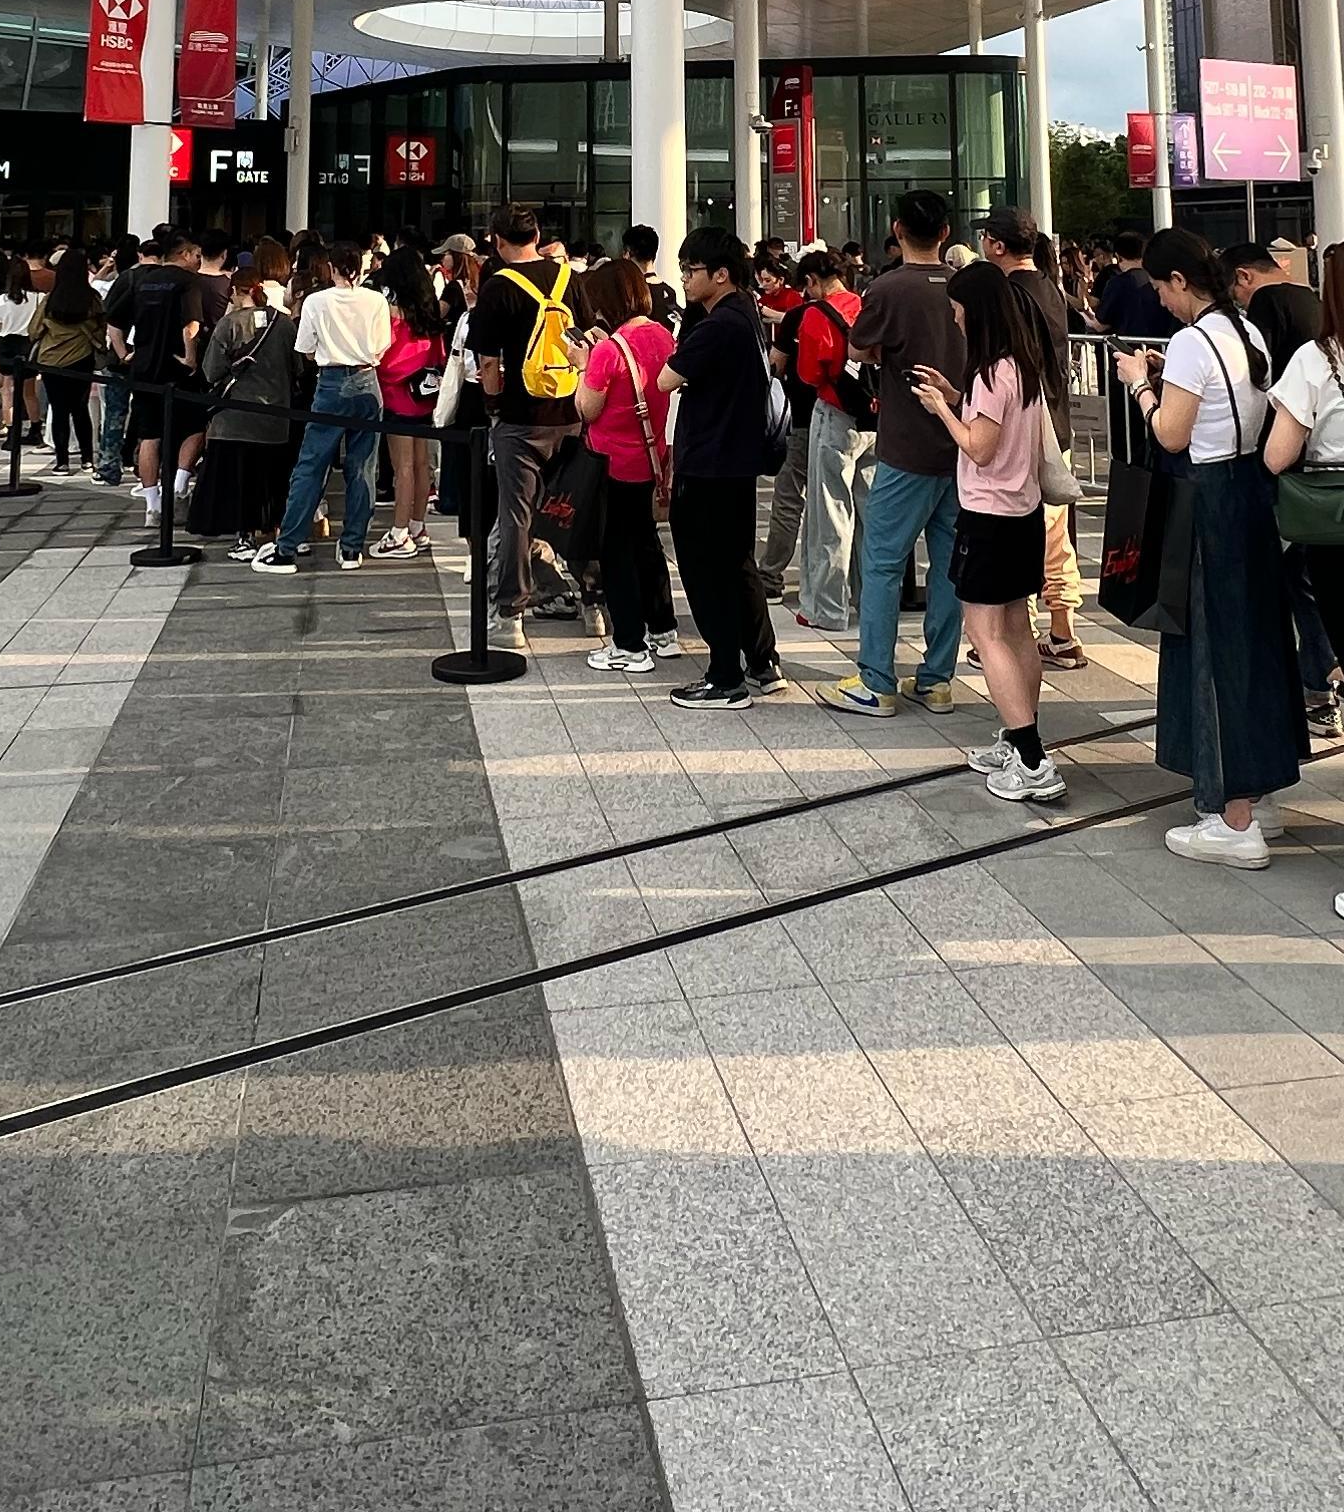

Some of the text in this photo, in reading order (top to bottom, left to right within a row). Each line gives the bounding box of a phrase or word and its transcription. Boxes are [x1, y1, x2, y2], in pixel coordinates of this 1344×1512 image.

[100, 33, 134, 51] HSBC
[867, 112, 948, 127] GALLERY
[209, 149, 233, 183] F
[236, 170, 269, 184] GATE
